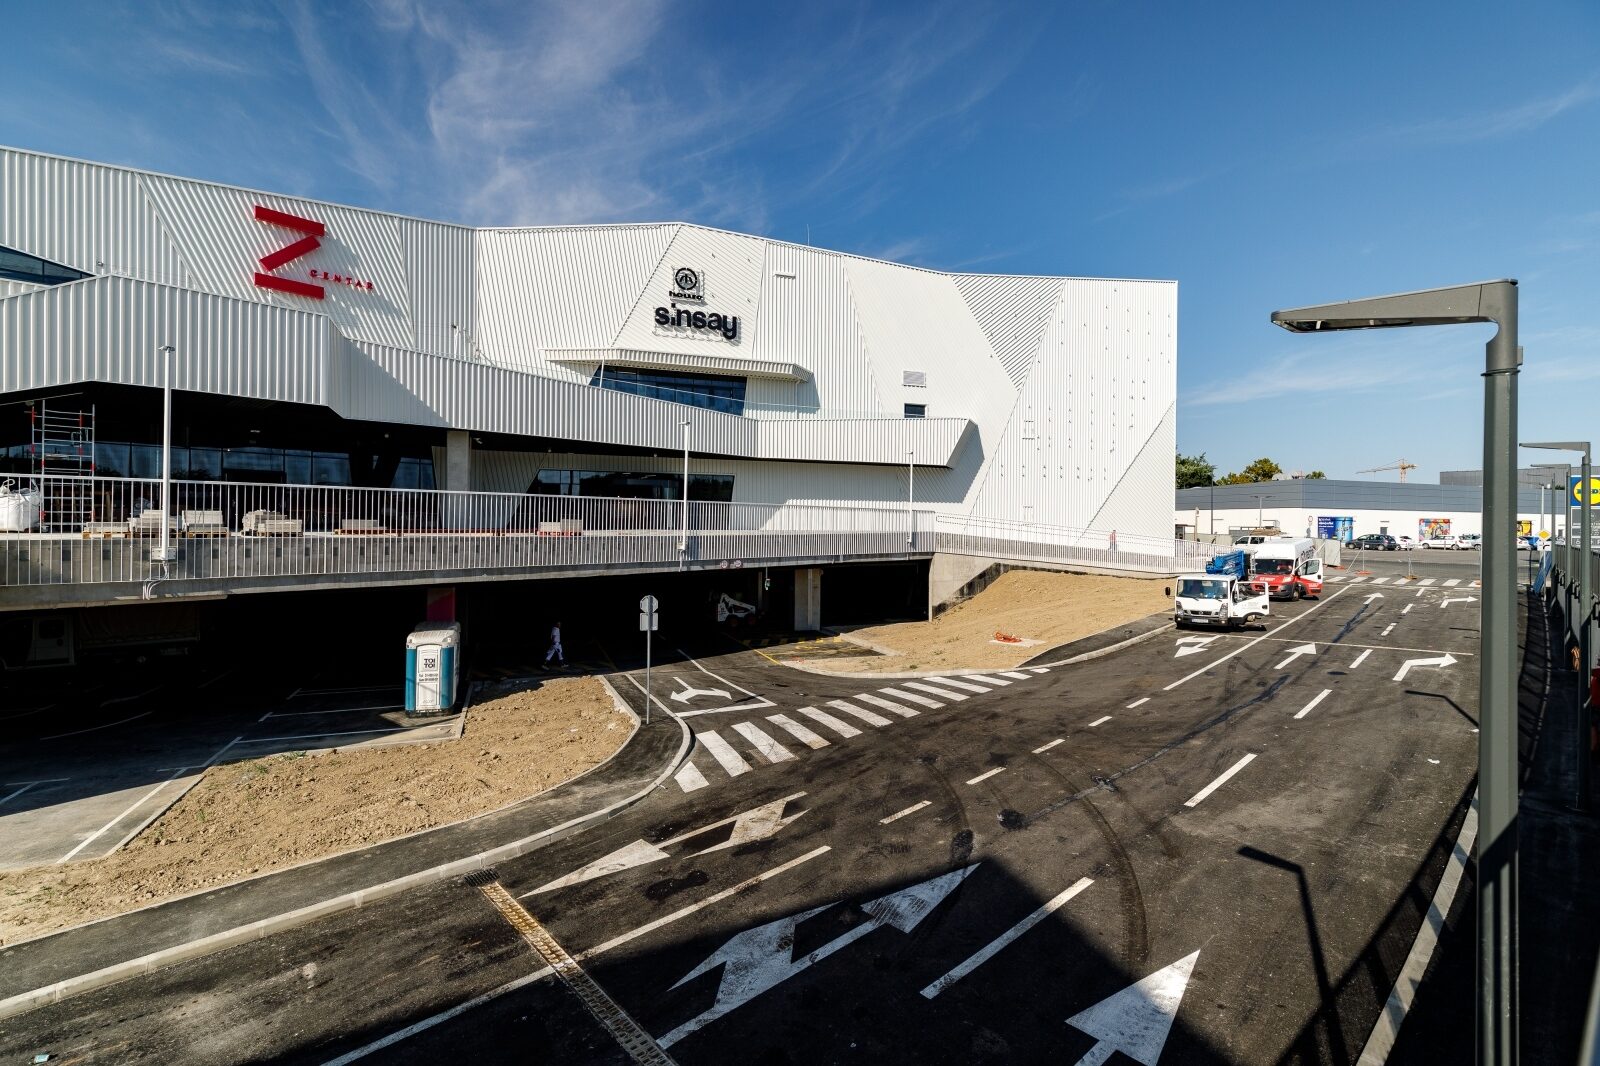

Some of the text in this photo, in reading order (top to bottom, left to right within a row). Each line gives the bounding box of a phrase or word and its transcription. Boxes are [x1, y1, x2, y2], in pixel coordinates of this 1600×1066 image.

[255, 205, 324, 299] Z
[309, 269, 373, 290] CENTAR
[655, 303, 737, 340] sinsay
